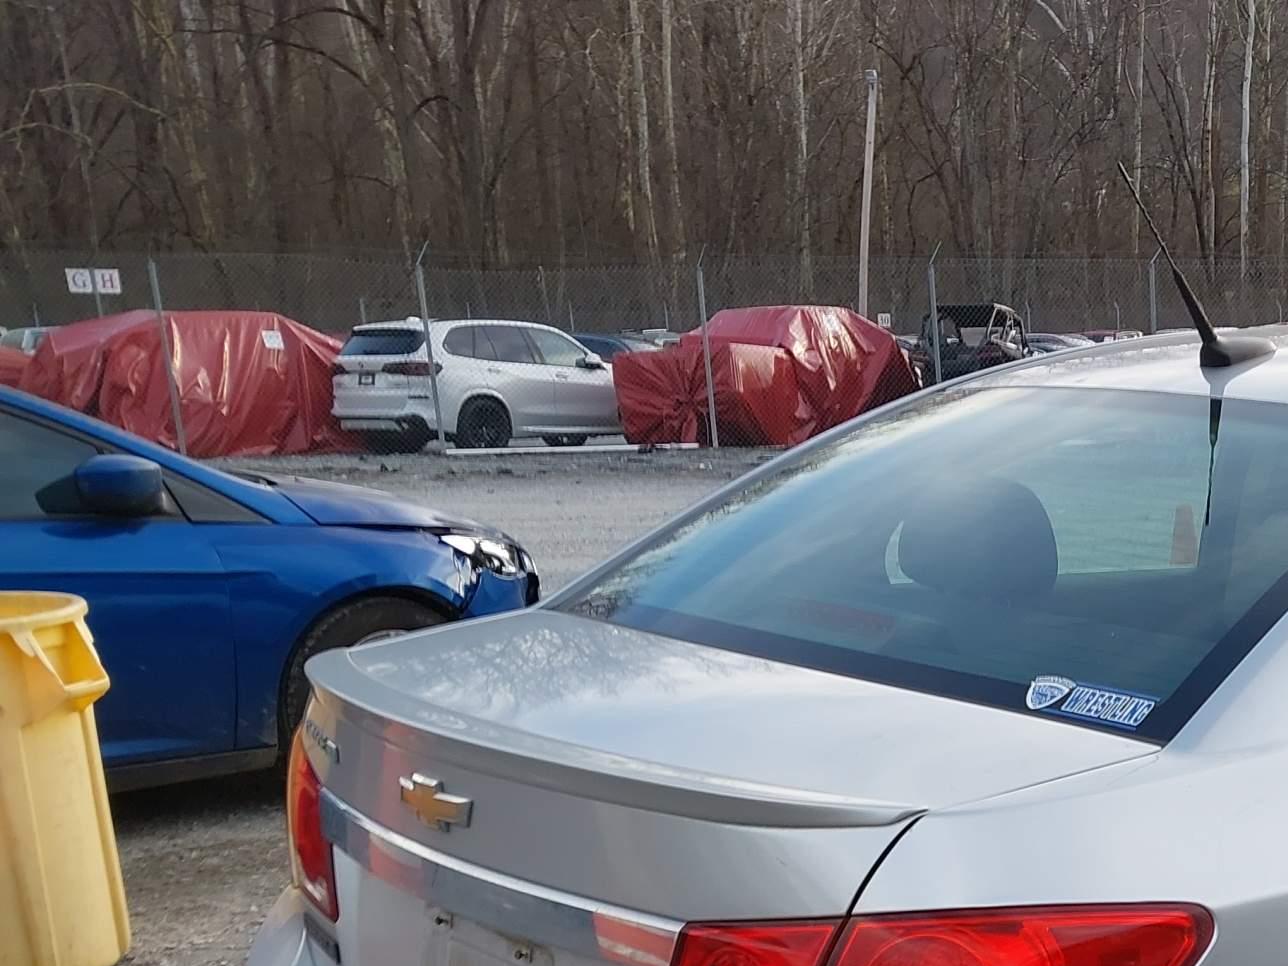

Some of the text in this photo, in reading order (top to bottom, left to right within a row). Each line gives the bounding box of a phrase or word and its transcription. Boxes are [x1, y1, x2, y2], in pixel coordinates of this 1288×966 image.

[72, 271, 114, 289] G H
[1060, 686, 1156, 727] WRESTLING
